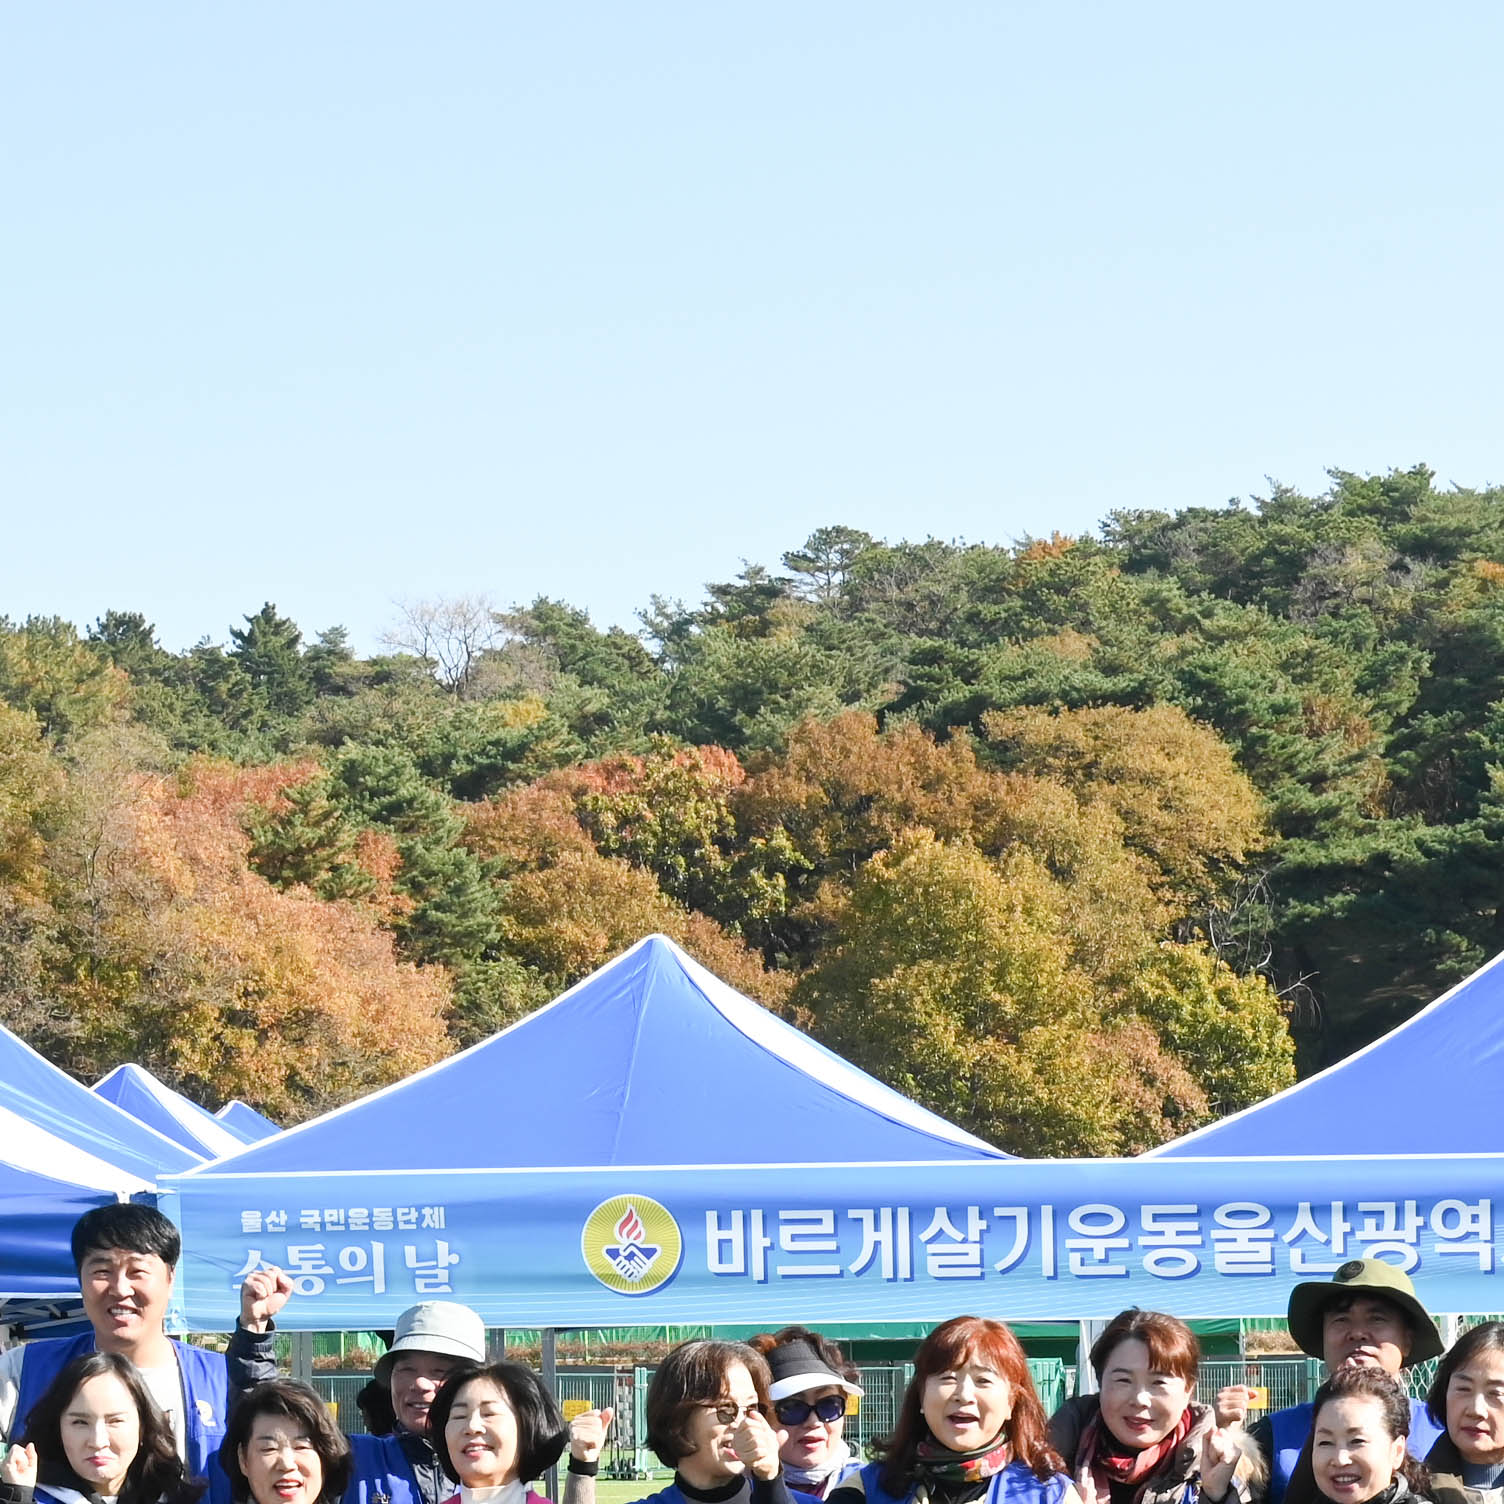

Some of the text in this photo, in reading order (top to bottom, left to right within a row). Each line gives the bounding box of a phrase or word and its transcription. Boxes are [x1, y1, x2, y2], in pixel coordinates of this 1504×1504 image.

[240, 1206, 446, 1233] 울산 국민운동단체
[404, 1239, 460, 1295] 날
